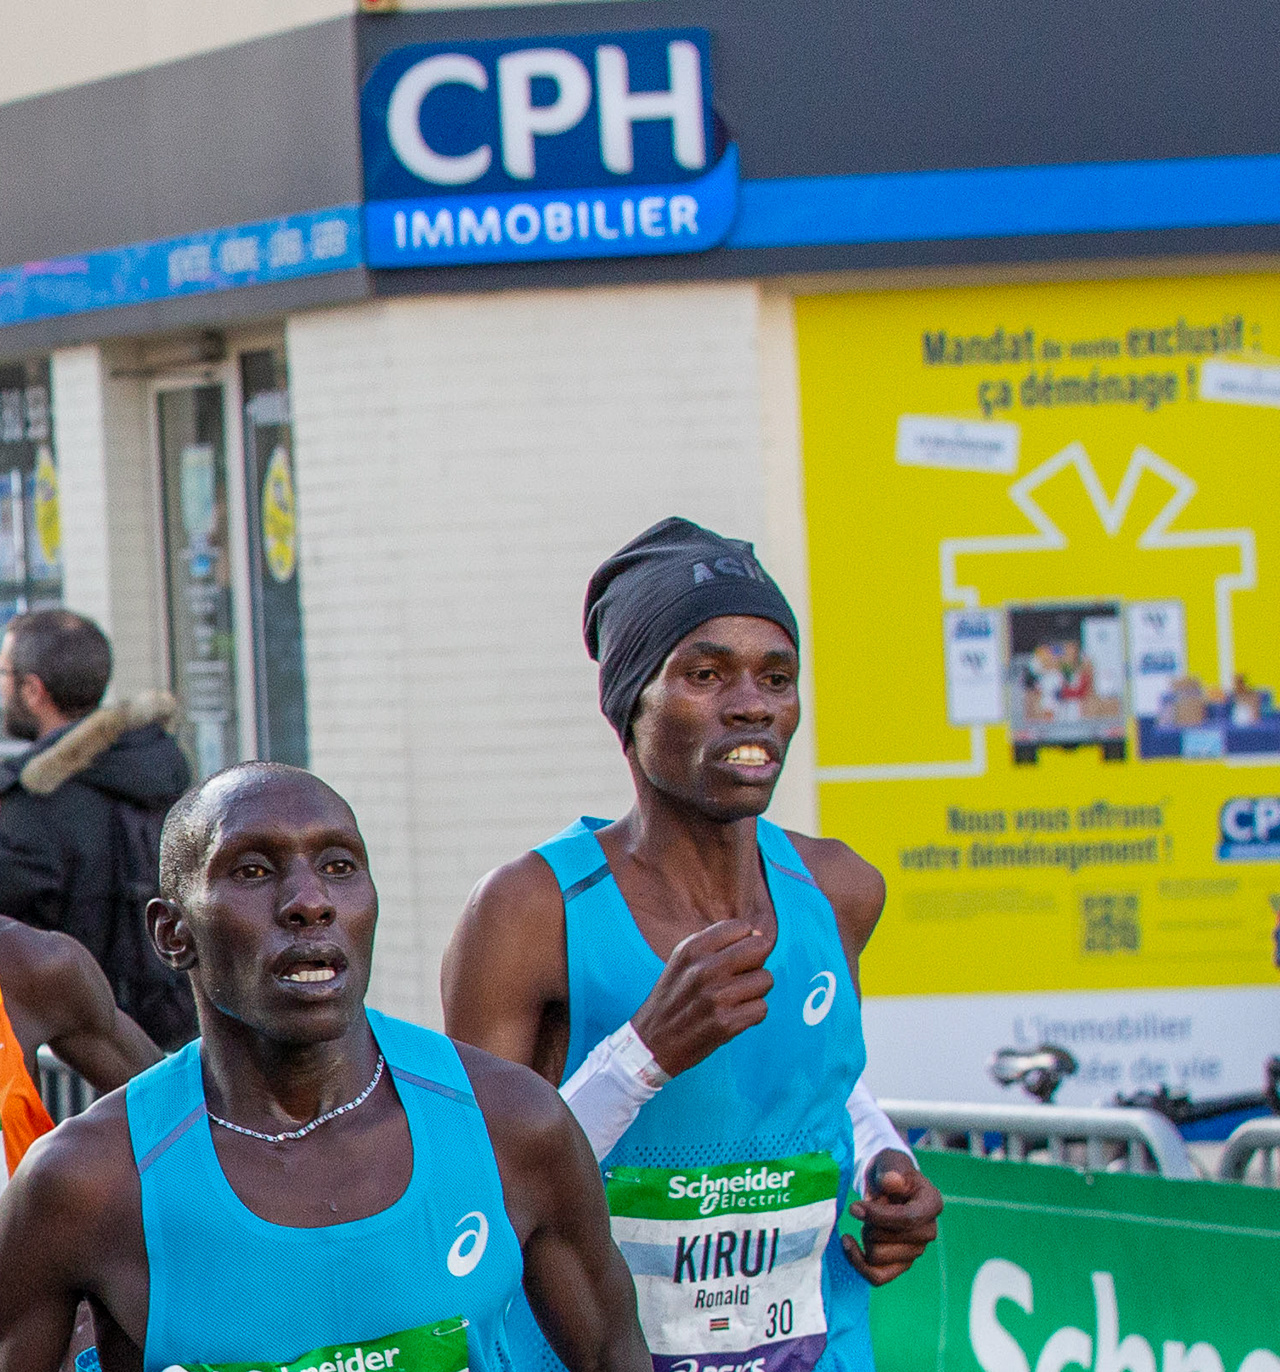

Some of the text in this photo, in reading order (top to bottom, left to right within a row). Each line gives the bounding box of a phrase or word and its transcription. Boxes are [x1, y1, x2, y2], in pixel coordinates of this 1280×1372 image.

[386, 40, 706, 185] CPH
[395, 195, 698, 250] IMMOBILIER
[922, 327, 1035, 366] Mandat
[692, 556, 766, 585] ASI
[1221, 799, 1280, 843] CP
[668, 1166, 795, 1199] Schneider
[721, 1191, 790, 1209] Electric
[673, 1227, 780, 1284] KIRUI
[694, 1284, 750, 1308] Ronald
[765, 1299, 794, 1338] 30
